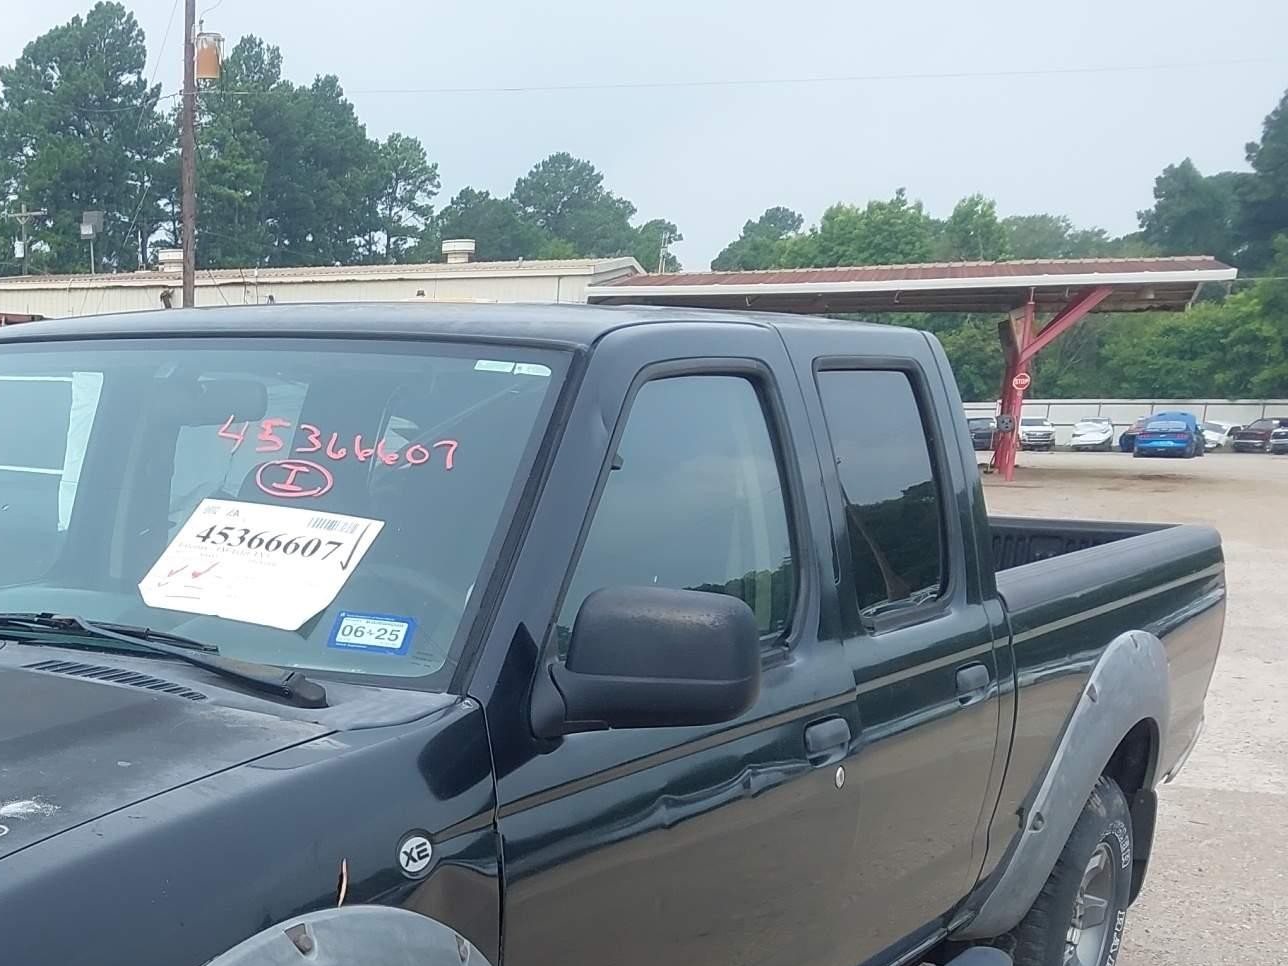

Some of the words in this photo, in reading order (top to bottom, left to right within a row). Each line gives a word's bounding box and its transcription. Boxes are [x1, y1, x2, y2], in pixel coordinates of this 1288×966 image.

[217, 414, 459, 470] 45366607
[195, 524, 344, 561] 45366607
[341, 624, 366, 638] 06
[375, 627, 401, 642] 25
